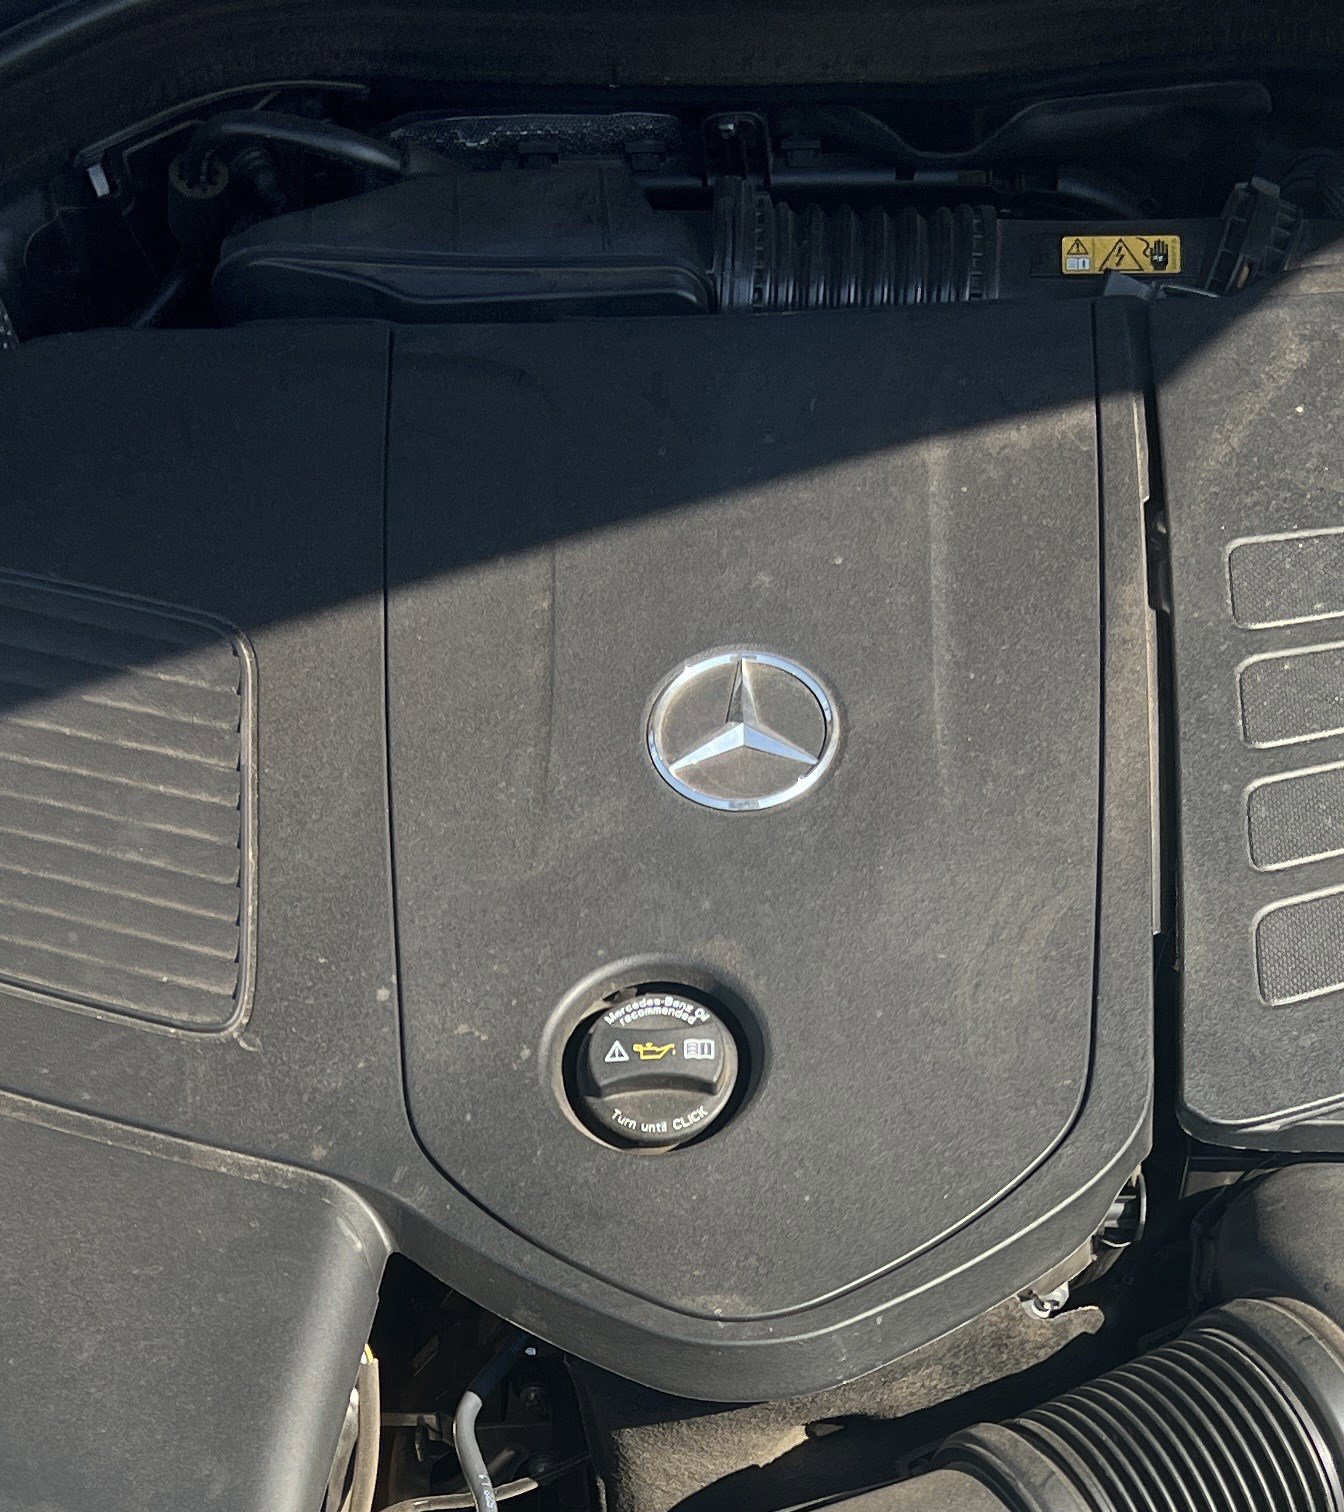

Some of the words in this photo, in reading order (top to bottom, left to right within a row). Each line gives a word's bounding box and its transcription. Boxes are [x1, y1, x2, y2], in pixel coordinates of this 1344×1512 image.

[603, 996, 694, 1025] Mercedes-Benz
[694, 1007, 711, 1022] Oil
[619, 1006, 697, 1026] recommended
[611, 1108, 637, 1130] Turn
[641, 1121, 667, 1133] until
[672, 1105, 709, 1131] CLICK
